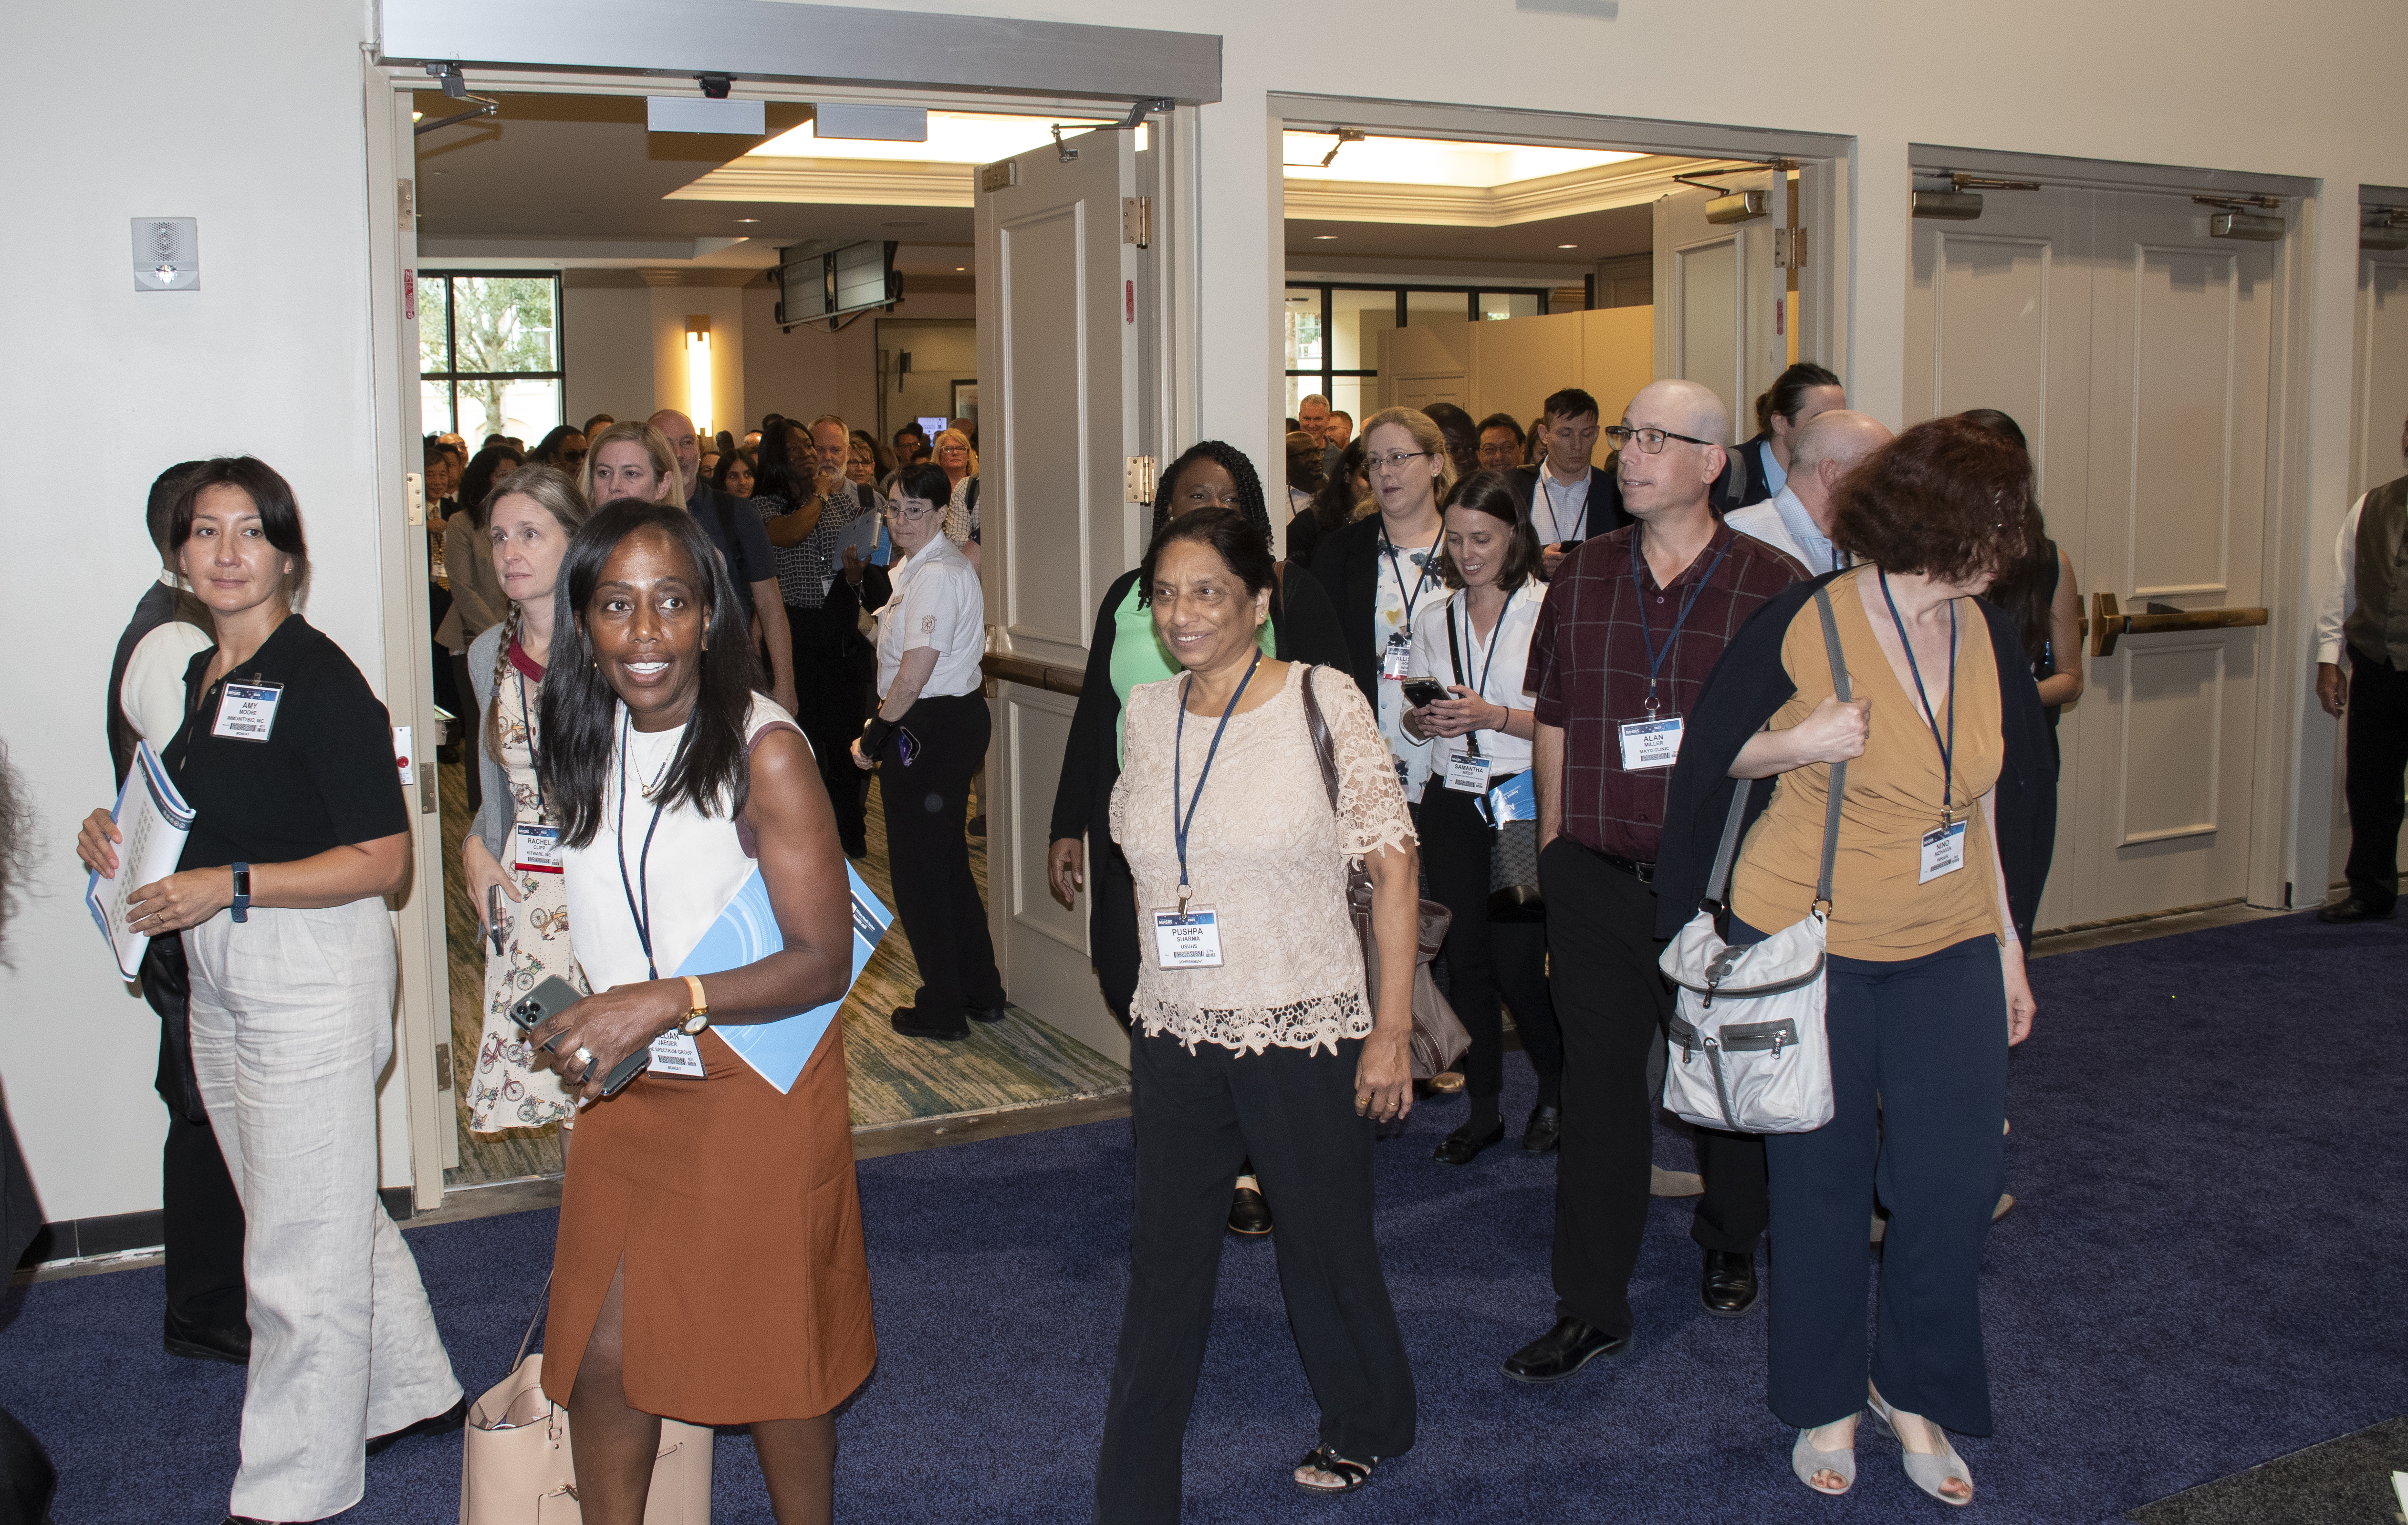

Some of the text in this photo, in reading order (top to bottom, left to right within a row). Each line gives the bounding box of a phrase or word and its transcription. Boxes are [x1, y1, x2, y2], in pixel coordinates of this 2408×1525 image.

[1644, 734, 1664, 742] ALAN
[1455, 764, 1483, 773] SAMANTHA
[1936, 840, 1949, 850] NINO
[853, 913, 867, 930] health.mil
[1172, 928, 1203, 936] PUSHPA
